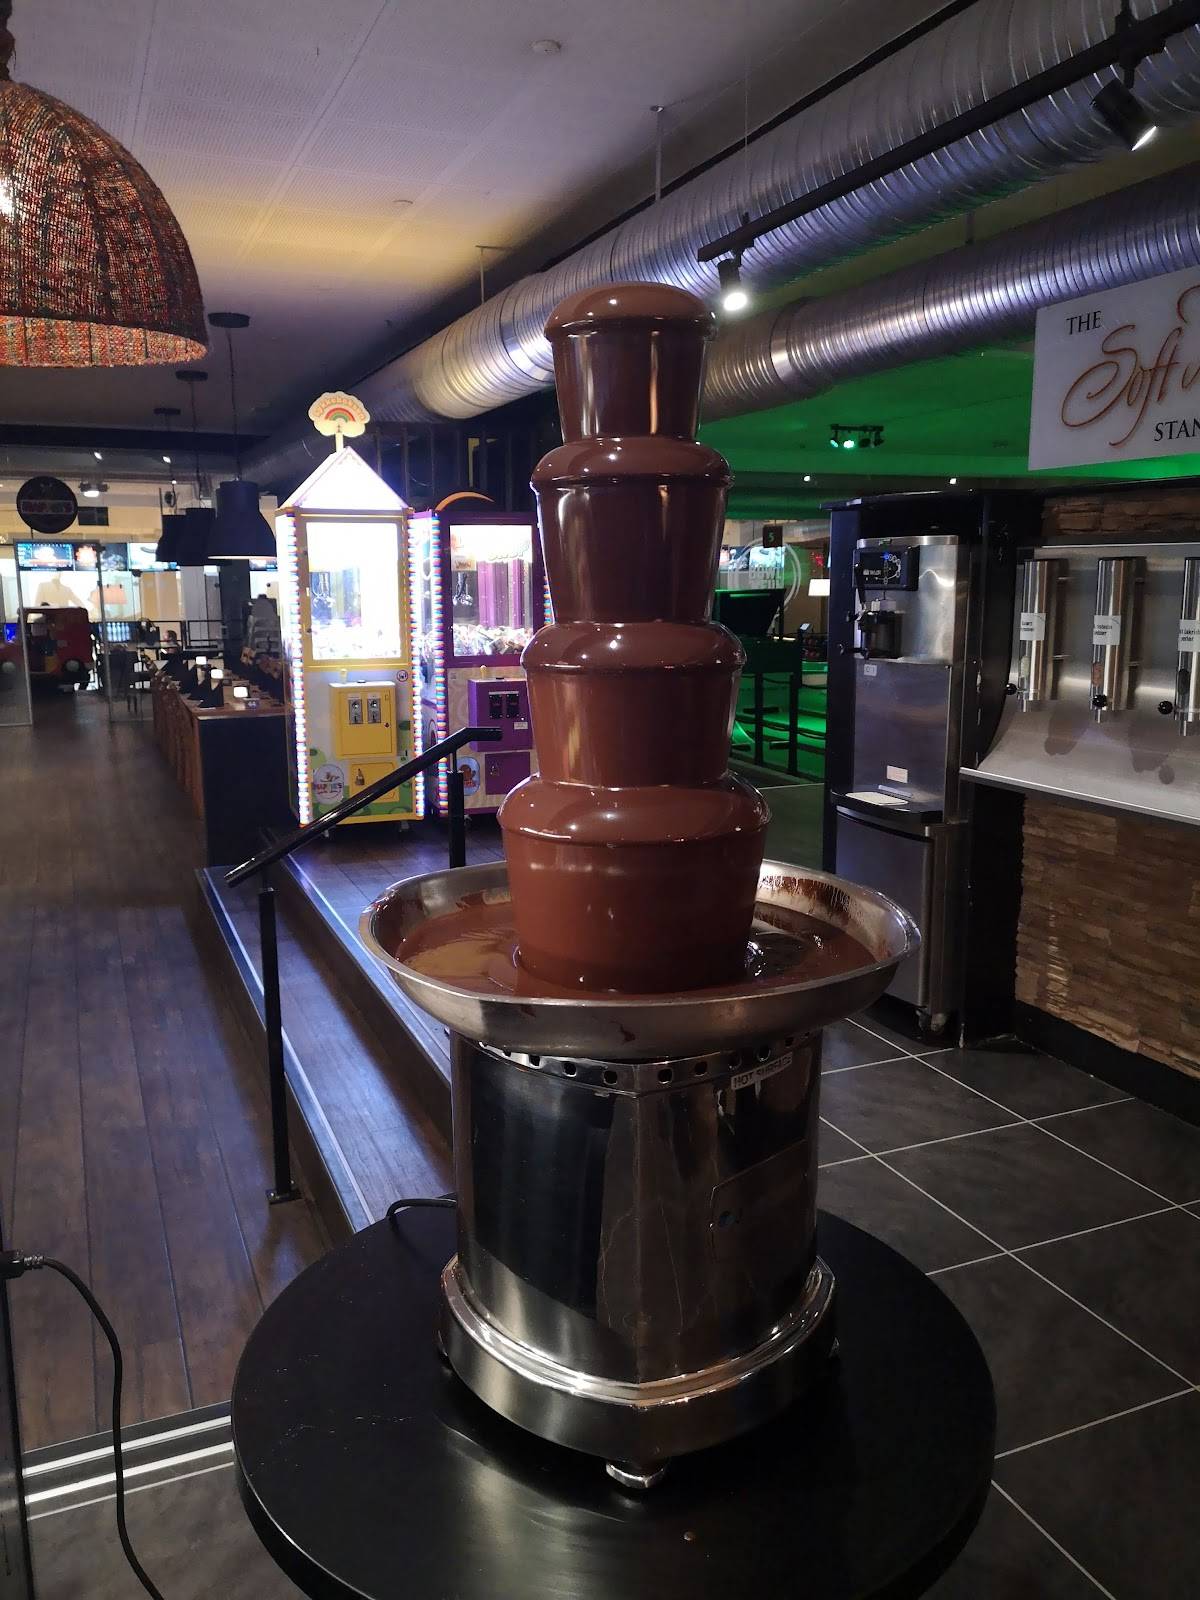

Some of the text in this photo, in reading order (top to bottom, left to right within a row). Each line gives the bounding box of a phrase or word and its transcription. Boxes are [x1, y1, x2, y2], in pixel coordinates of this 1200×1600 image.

[1066, 310, 1102, 335] THE
[1061, 324, 1182, 446] Soft
[733, 1072, 753, 1088] HOT
